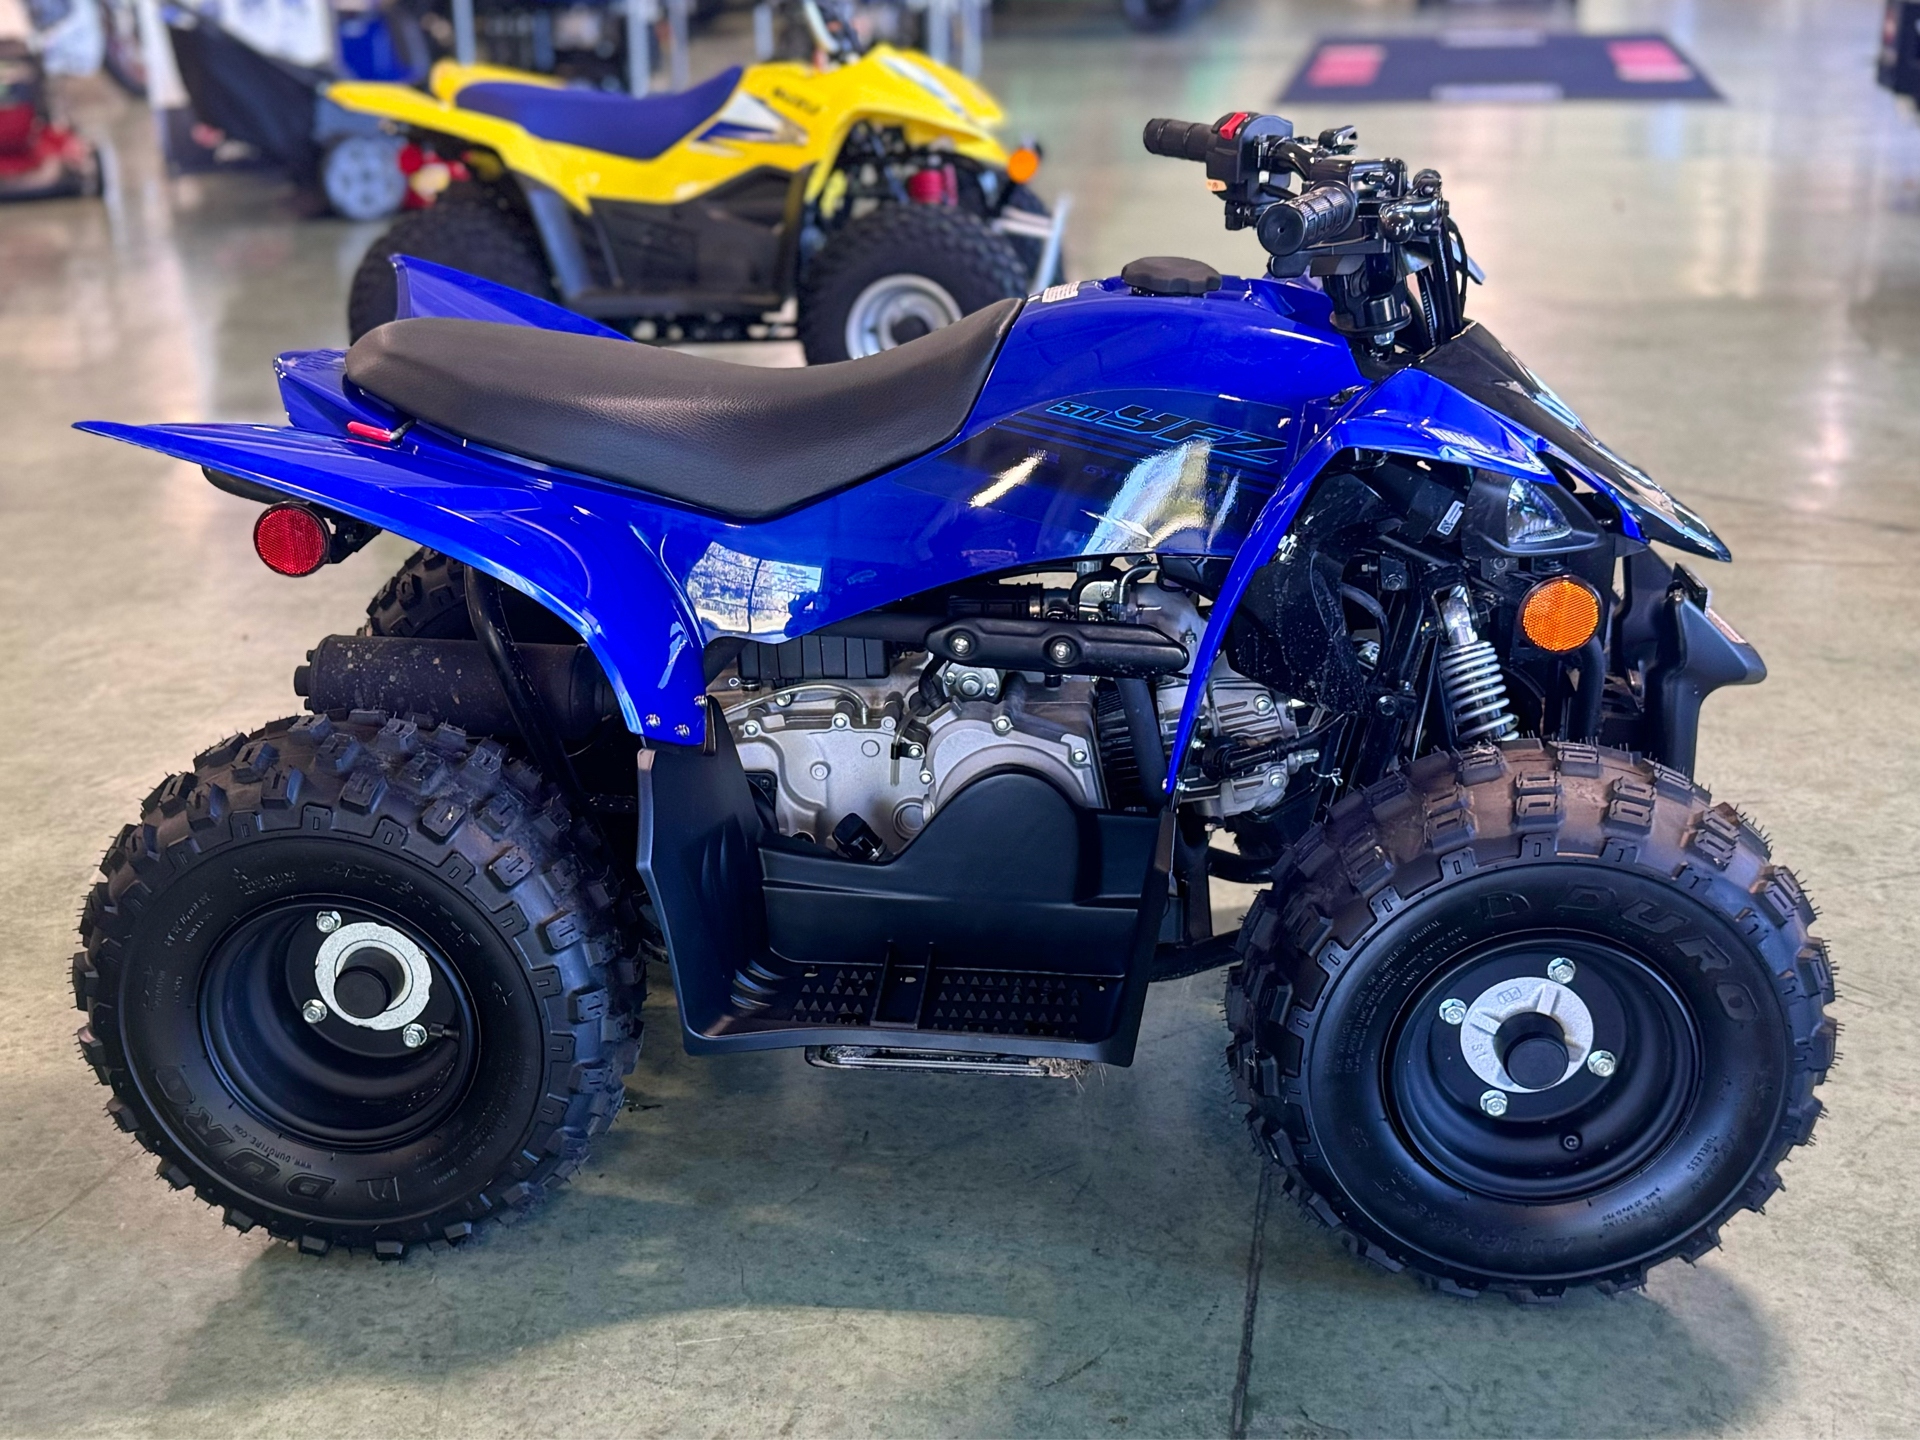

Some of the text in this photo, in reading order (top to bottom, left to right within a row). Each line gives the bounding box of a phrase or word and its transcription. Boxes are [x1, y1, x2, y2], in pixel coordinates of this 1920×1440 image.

[1045, 400, 1113, 423] 50
[1095, 403, 1289, 466] YFZ
[1687, 1134, 1718, 1171] TUBELESS
